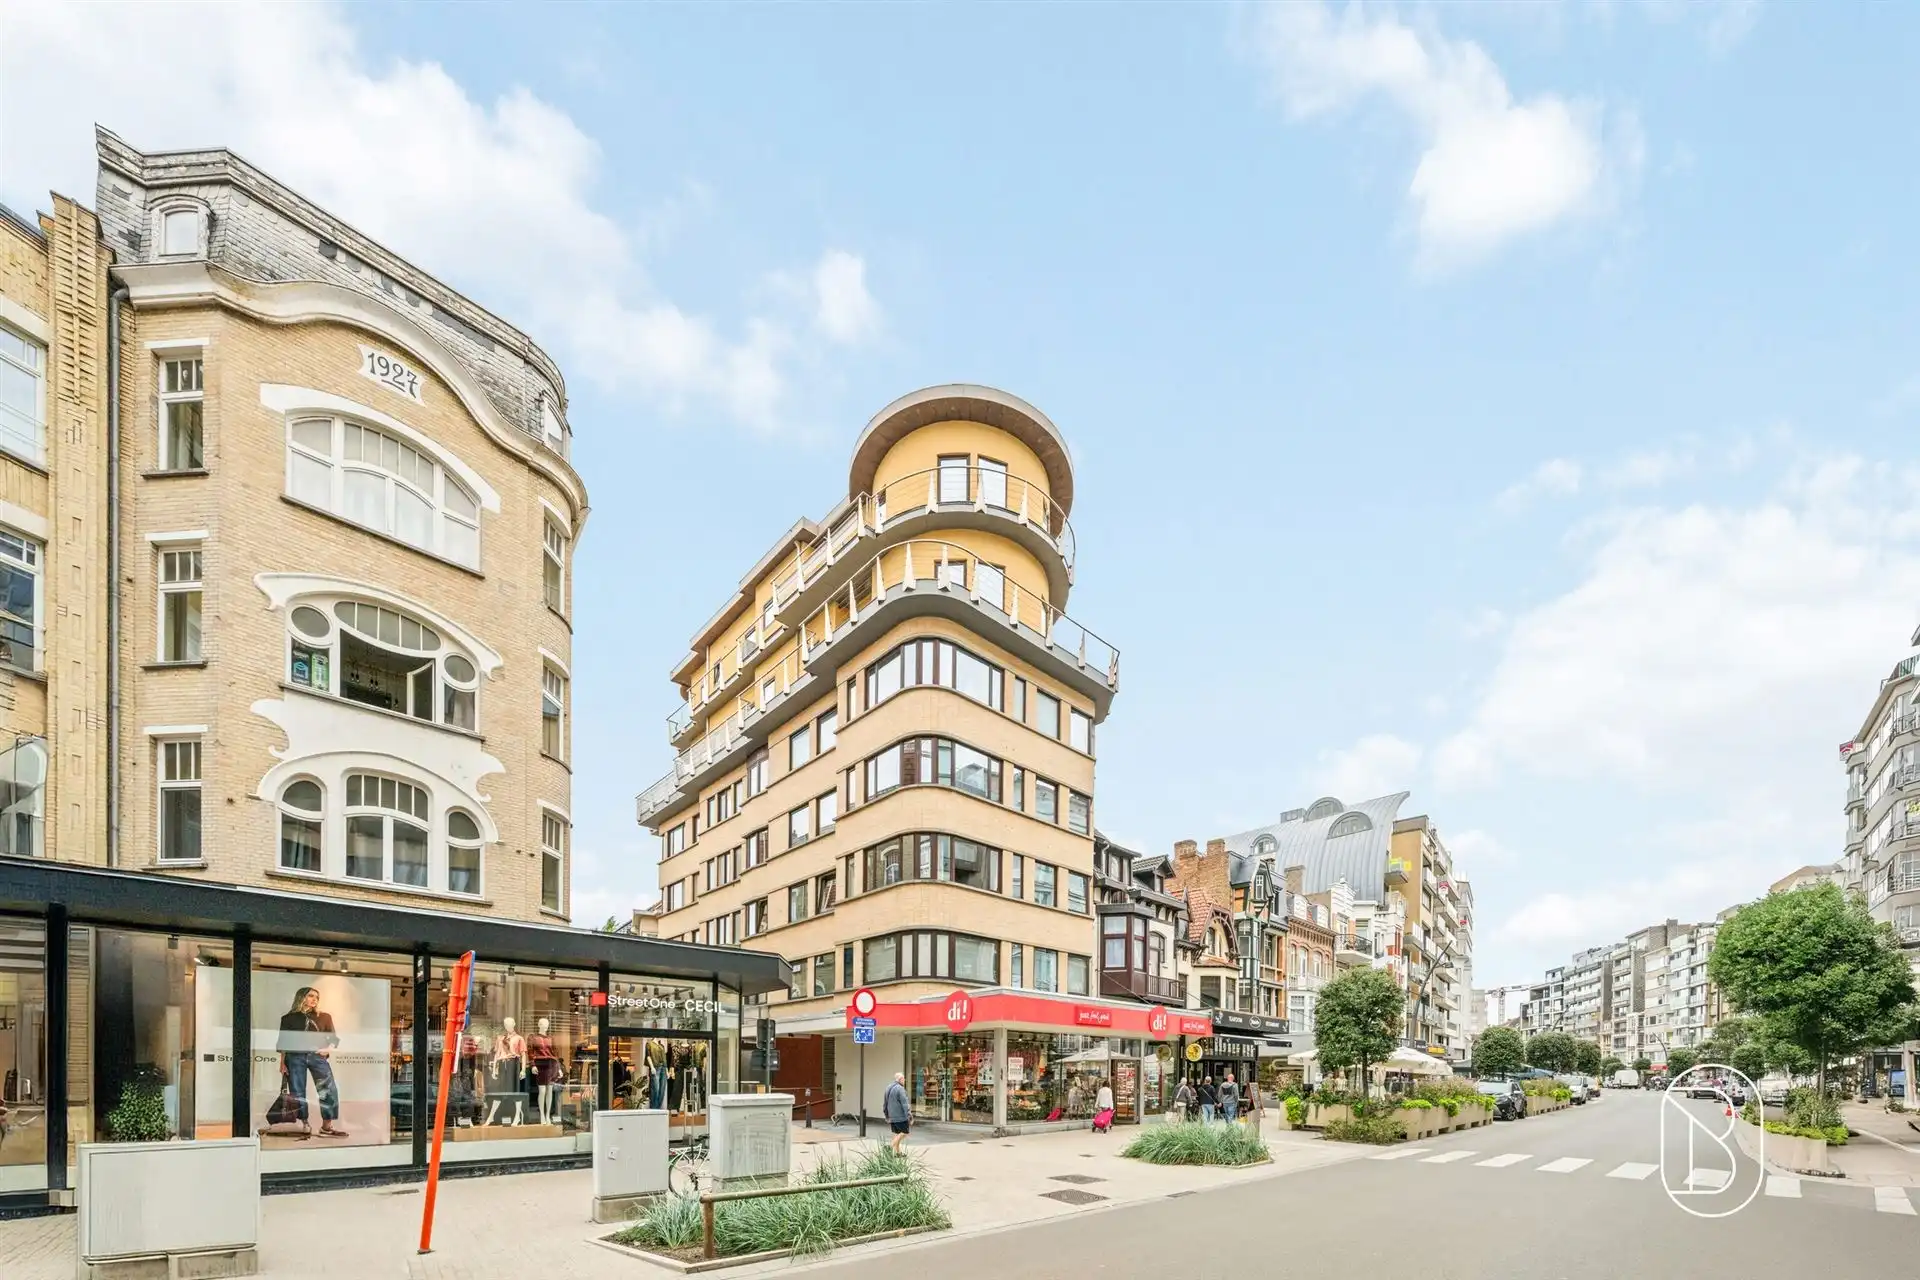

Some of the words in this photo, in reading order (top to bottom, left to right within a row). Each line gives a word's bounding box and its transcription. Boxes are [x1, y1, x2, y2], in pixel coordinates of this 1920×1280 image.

[367, 352, 418, 399] 1927
[684, 999, 726, 1014] CECIL
[948, 999, 968, 1022] di!
[254, 1055, 277, 1063] One
